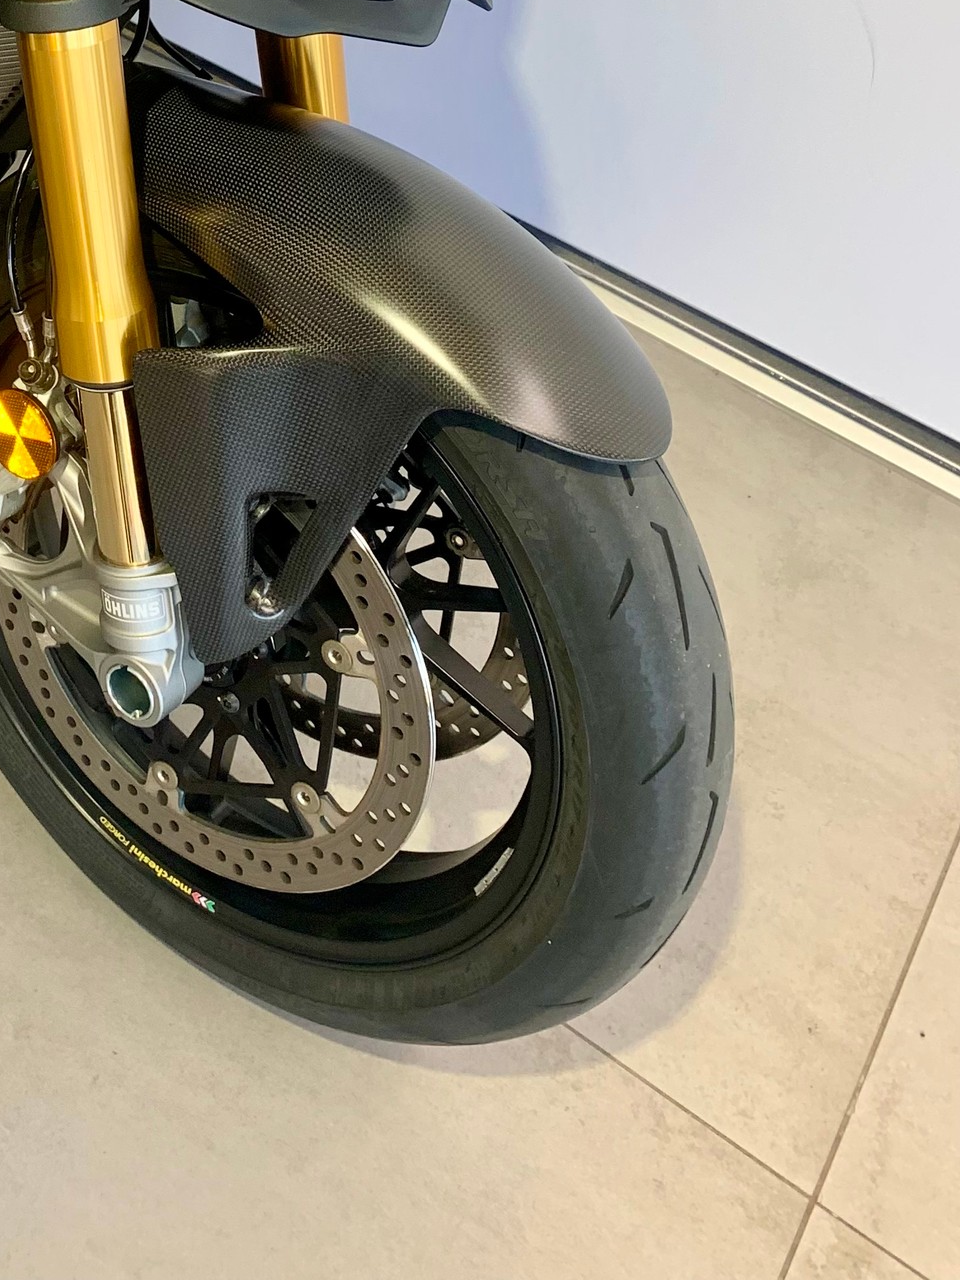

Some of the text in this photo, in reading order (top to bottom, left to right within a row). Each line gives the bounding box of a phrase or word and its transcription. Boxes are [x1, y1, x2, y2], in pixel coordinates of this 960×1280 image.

[103, 592, 161, 619] ÖHLINS
[99, 815, 193, 896] marchesini FORGED
